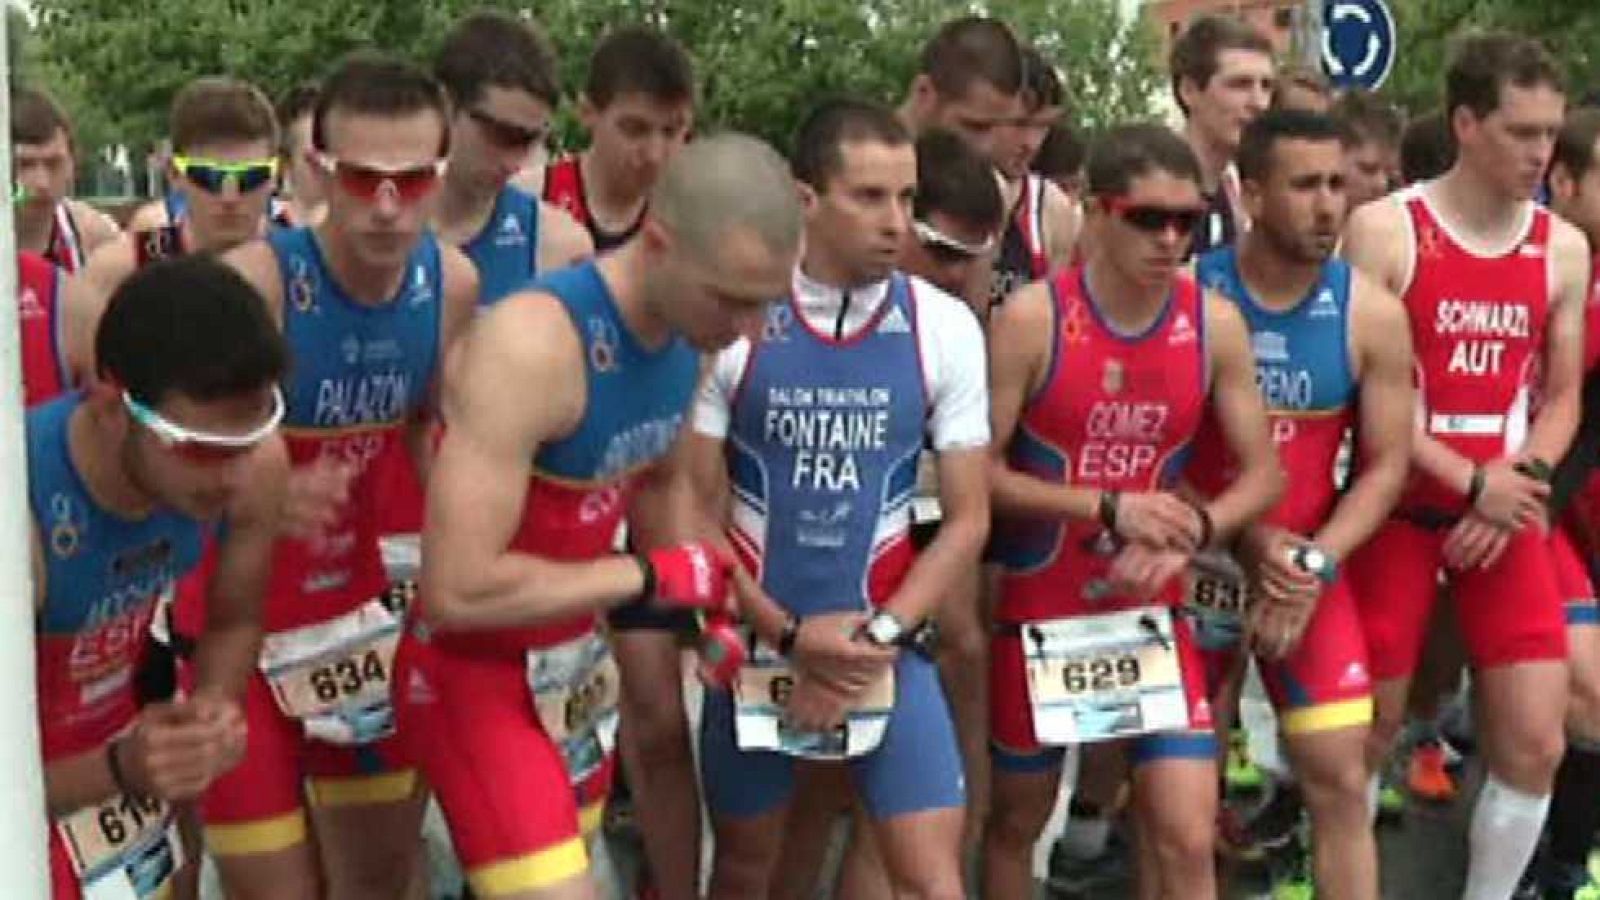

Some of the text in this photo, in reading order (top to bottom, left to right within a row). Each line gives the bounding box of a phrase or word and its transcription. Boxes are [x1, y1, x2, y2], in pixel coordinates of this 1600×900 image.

[1447, 340, 1506, 375] AUT
[764, 410, 889, 450] FONTAINE
[791, 453, 861, 492] FRA
[1077, 444, 1156, 478] ESP
[310, 649, 387, 703] 634
[1061, 654, 1141, 694] 629
